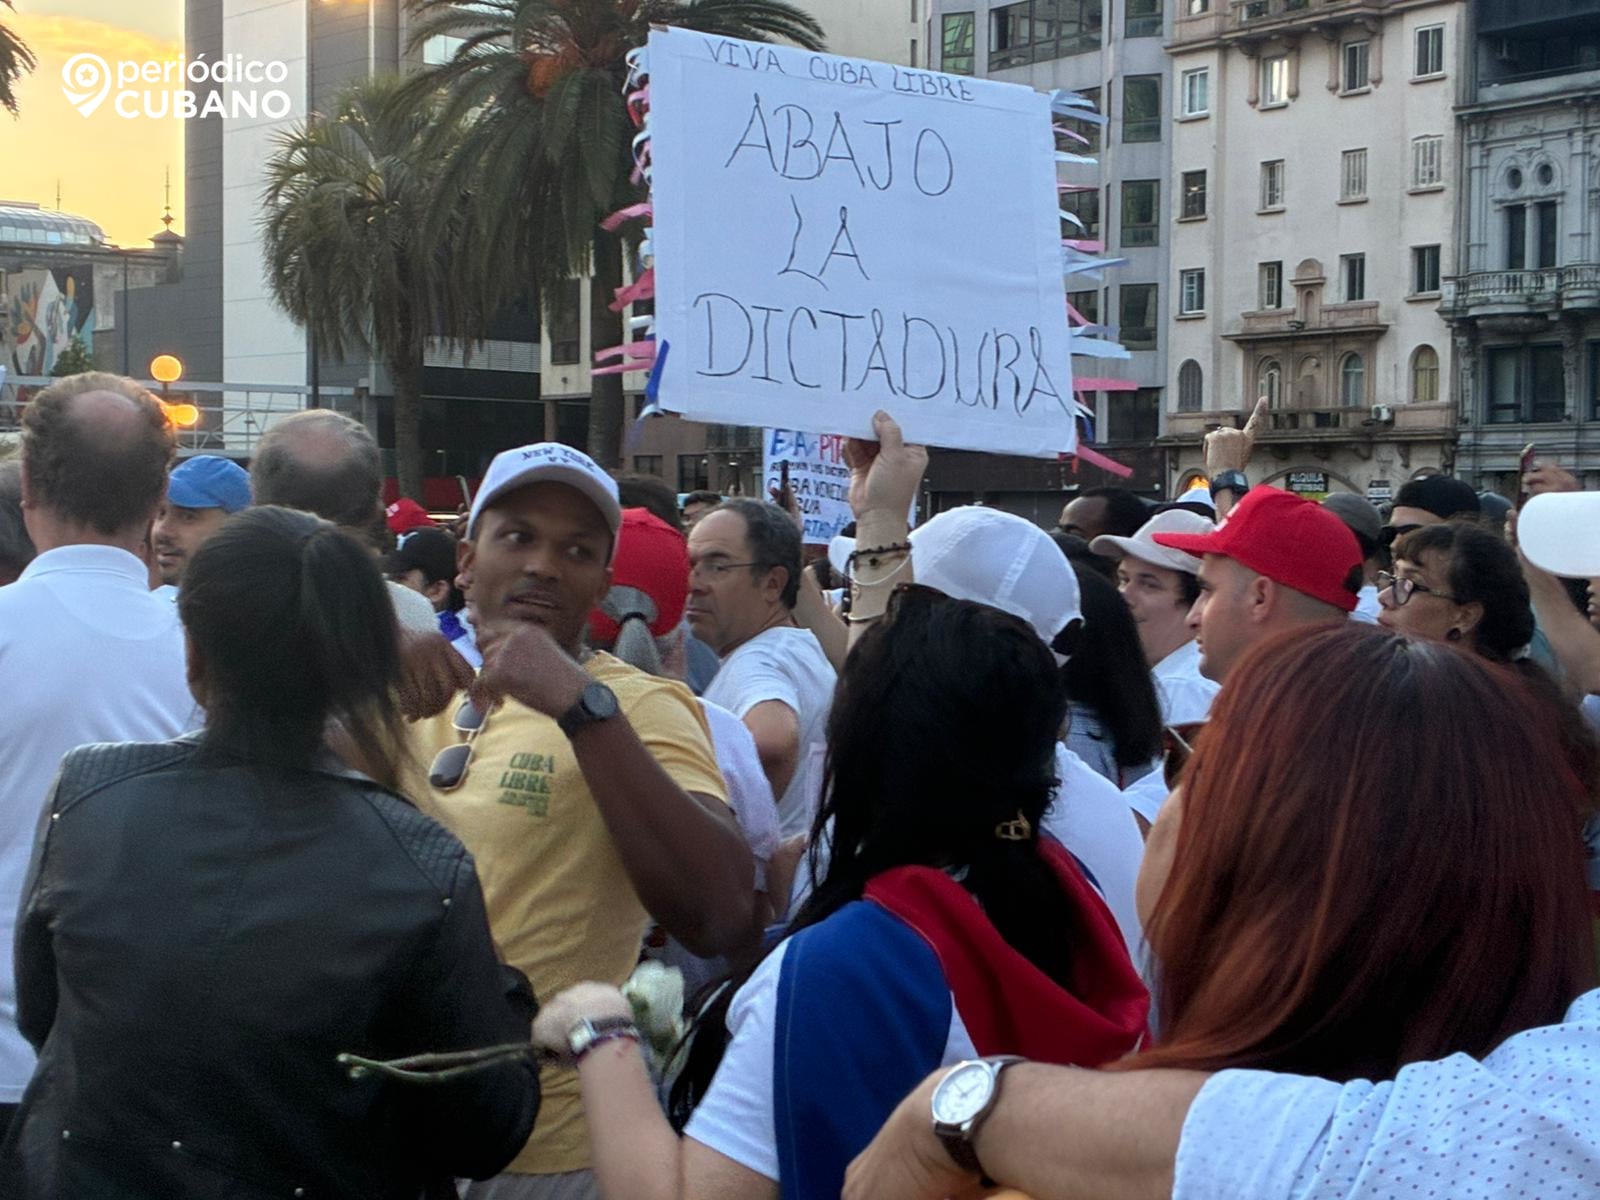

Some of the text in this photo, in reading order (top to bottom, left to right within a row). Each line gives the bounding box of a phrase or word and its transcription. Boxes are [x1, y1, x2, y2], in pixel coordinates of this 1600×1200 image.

[703, 38, 975, 101] VIVA CUBA LIBRE
[724, 92, 954, 197] ABAJO
[777, 194, 870, 290] LA
[693, 292, 1072, 419] DICTADURA
[521, 447, 596, 473] NEW YORK
[766, 477, 812, 497] CBA
[498, 770, 553, 794] LIBRE
[509, 752, 555, 774] CUBA
